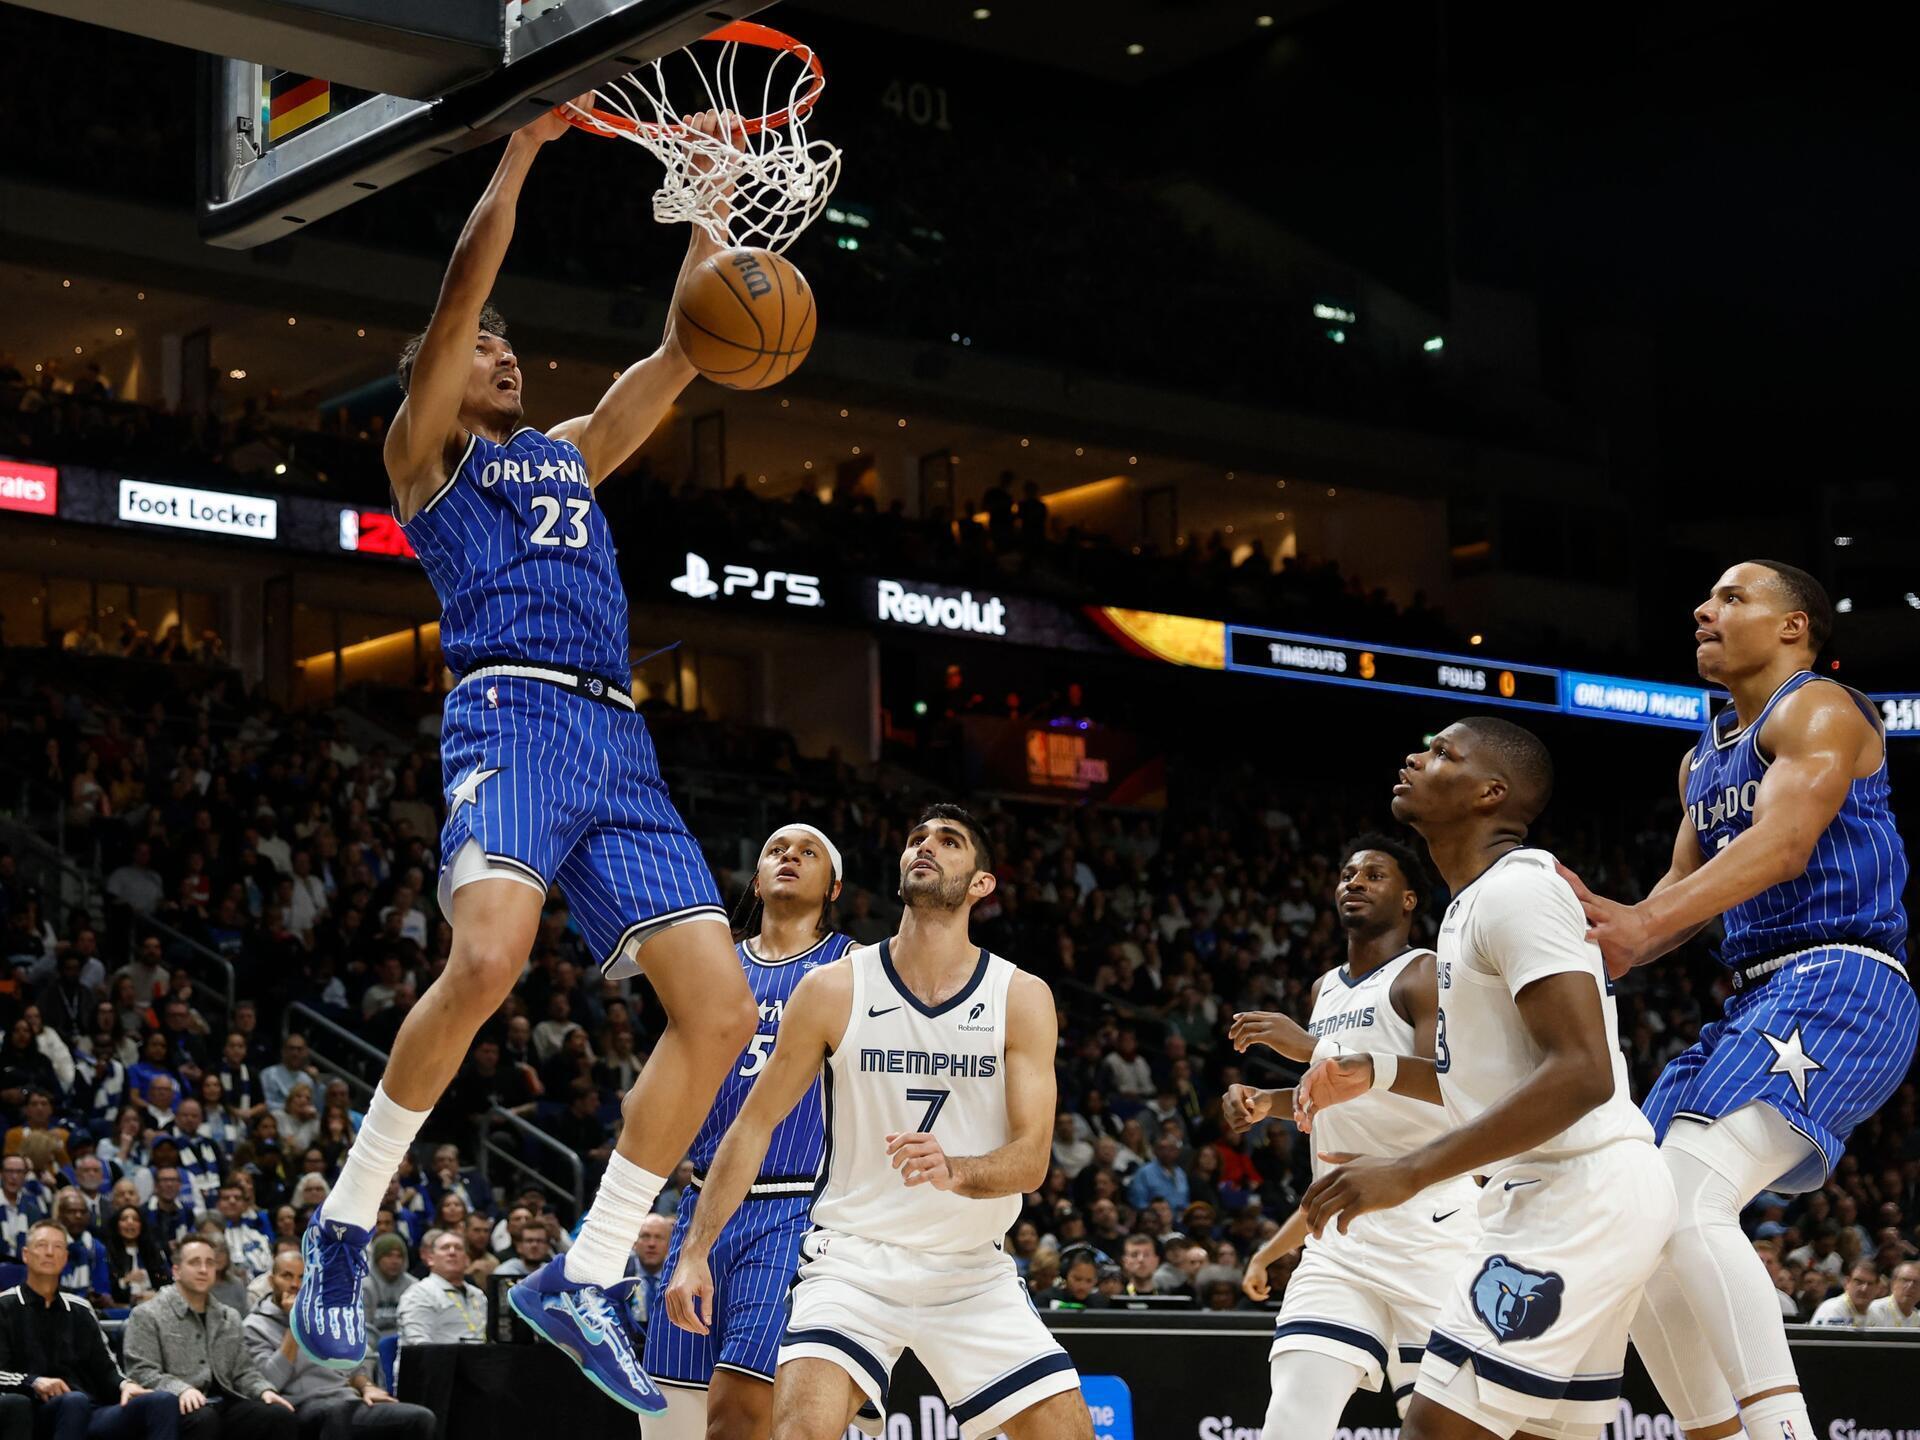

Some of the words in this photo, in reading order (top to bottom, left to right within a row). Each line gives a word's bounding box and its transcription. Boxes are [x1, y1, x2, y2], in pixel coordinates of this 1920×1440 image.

[881, 79, 952, 131] 401
[129, 490, 178, 517] Foot
[190, 499, 267, 528] Locker
[530, 495, 591, 548] 23
[723, 564, 820, 607] PS5
[877, 579, 1006, 636] Revolut
[1268, 643, 1347, 672] TIMEOUTS
[1358, 651, 1375, 680] 5
[1437, 665, 1486, 691] FOULS
[1499, 670, 1515, 697] 0
[1573, 682, 1648, 714] ORLANDO
[1648, 691, 1700, 721] MAGIC
[957, 1024, 995, 1032] Robinhood
[738, 1034, 776, 1077] 5
[860, 1048, 997, 1078] MEMPHIS
[906, 1088, 951, 1133] 7
